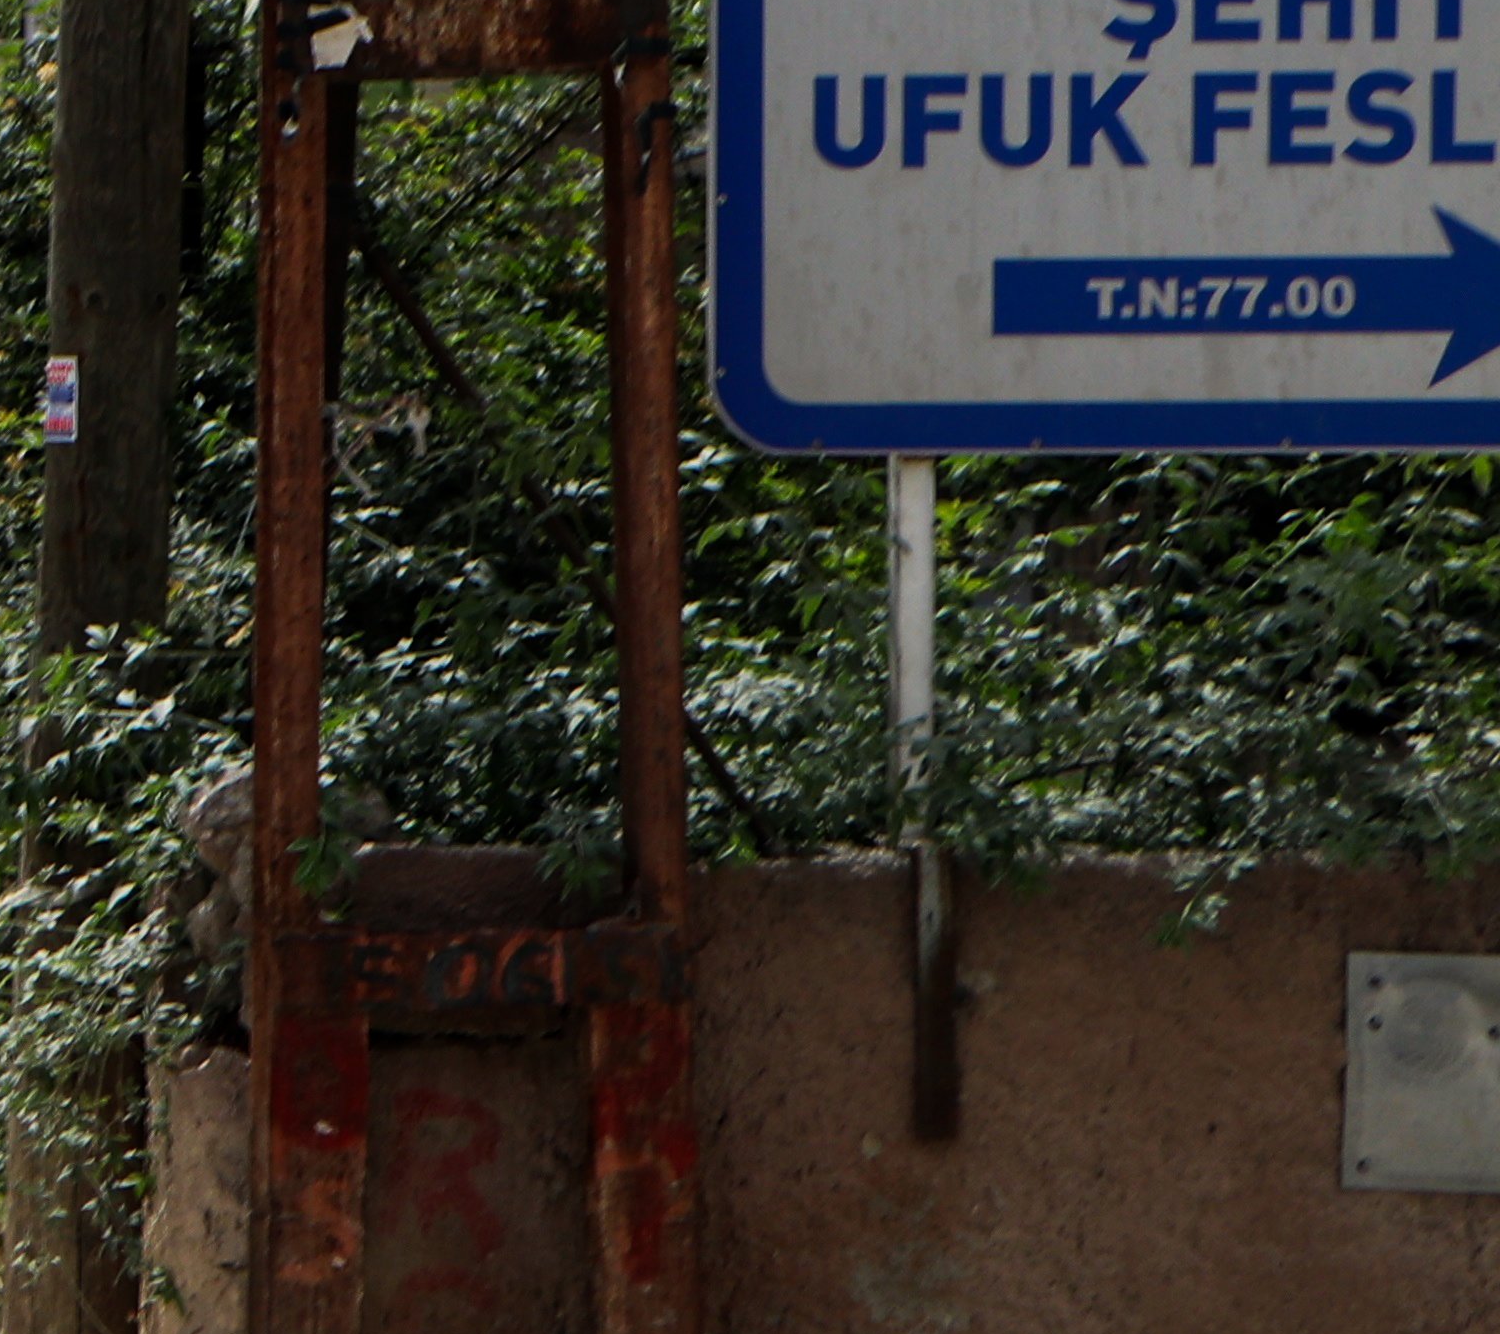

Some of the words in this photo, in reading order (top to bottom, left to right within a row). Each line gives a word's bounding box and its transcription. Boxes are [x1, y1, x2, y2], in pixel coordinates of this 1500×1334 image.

[813, 69, 1151, 168] UFUK
[1188, 68, 1497, 166] FESL
[1085, 275, 1357, 321] T.N:77.00
